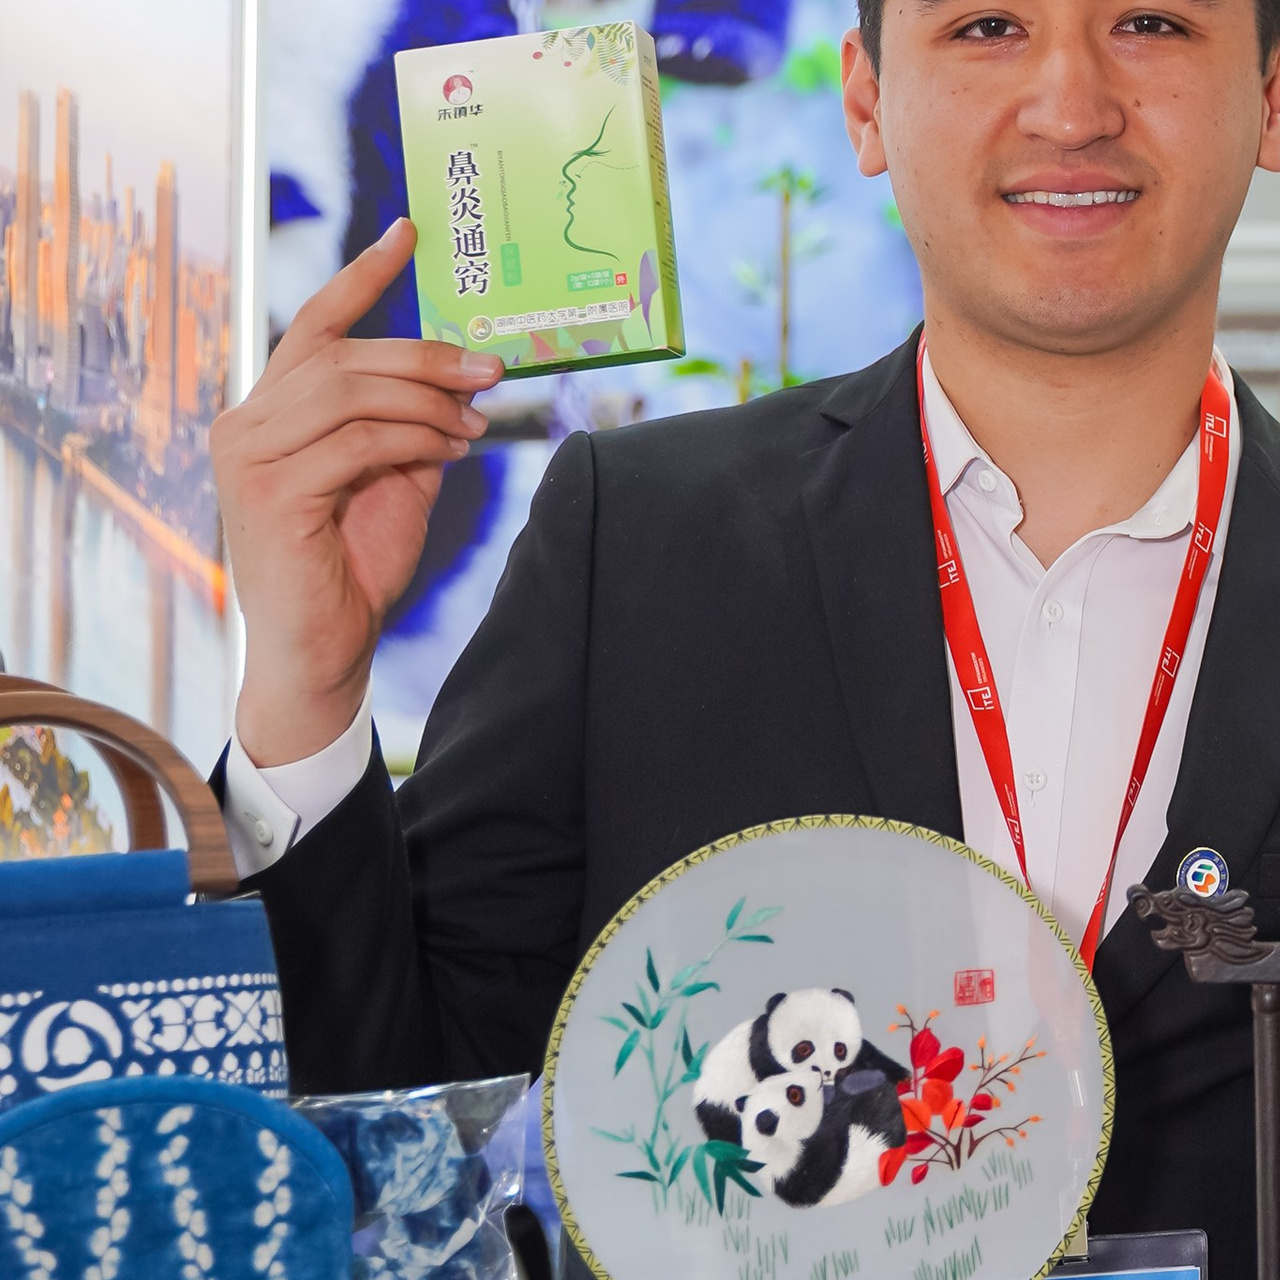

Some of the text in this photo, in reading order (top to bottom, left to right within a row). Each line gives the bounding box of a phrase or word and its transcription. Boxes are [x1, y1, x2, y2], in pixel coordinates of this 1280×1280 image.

[446, 150, 490, 295] 鼻炎通窍
[947, 563, 960, 584] ITE
[982, 692, 995, 710] ITE
